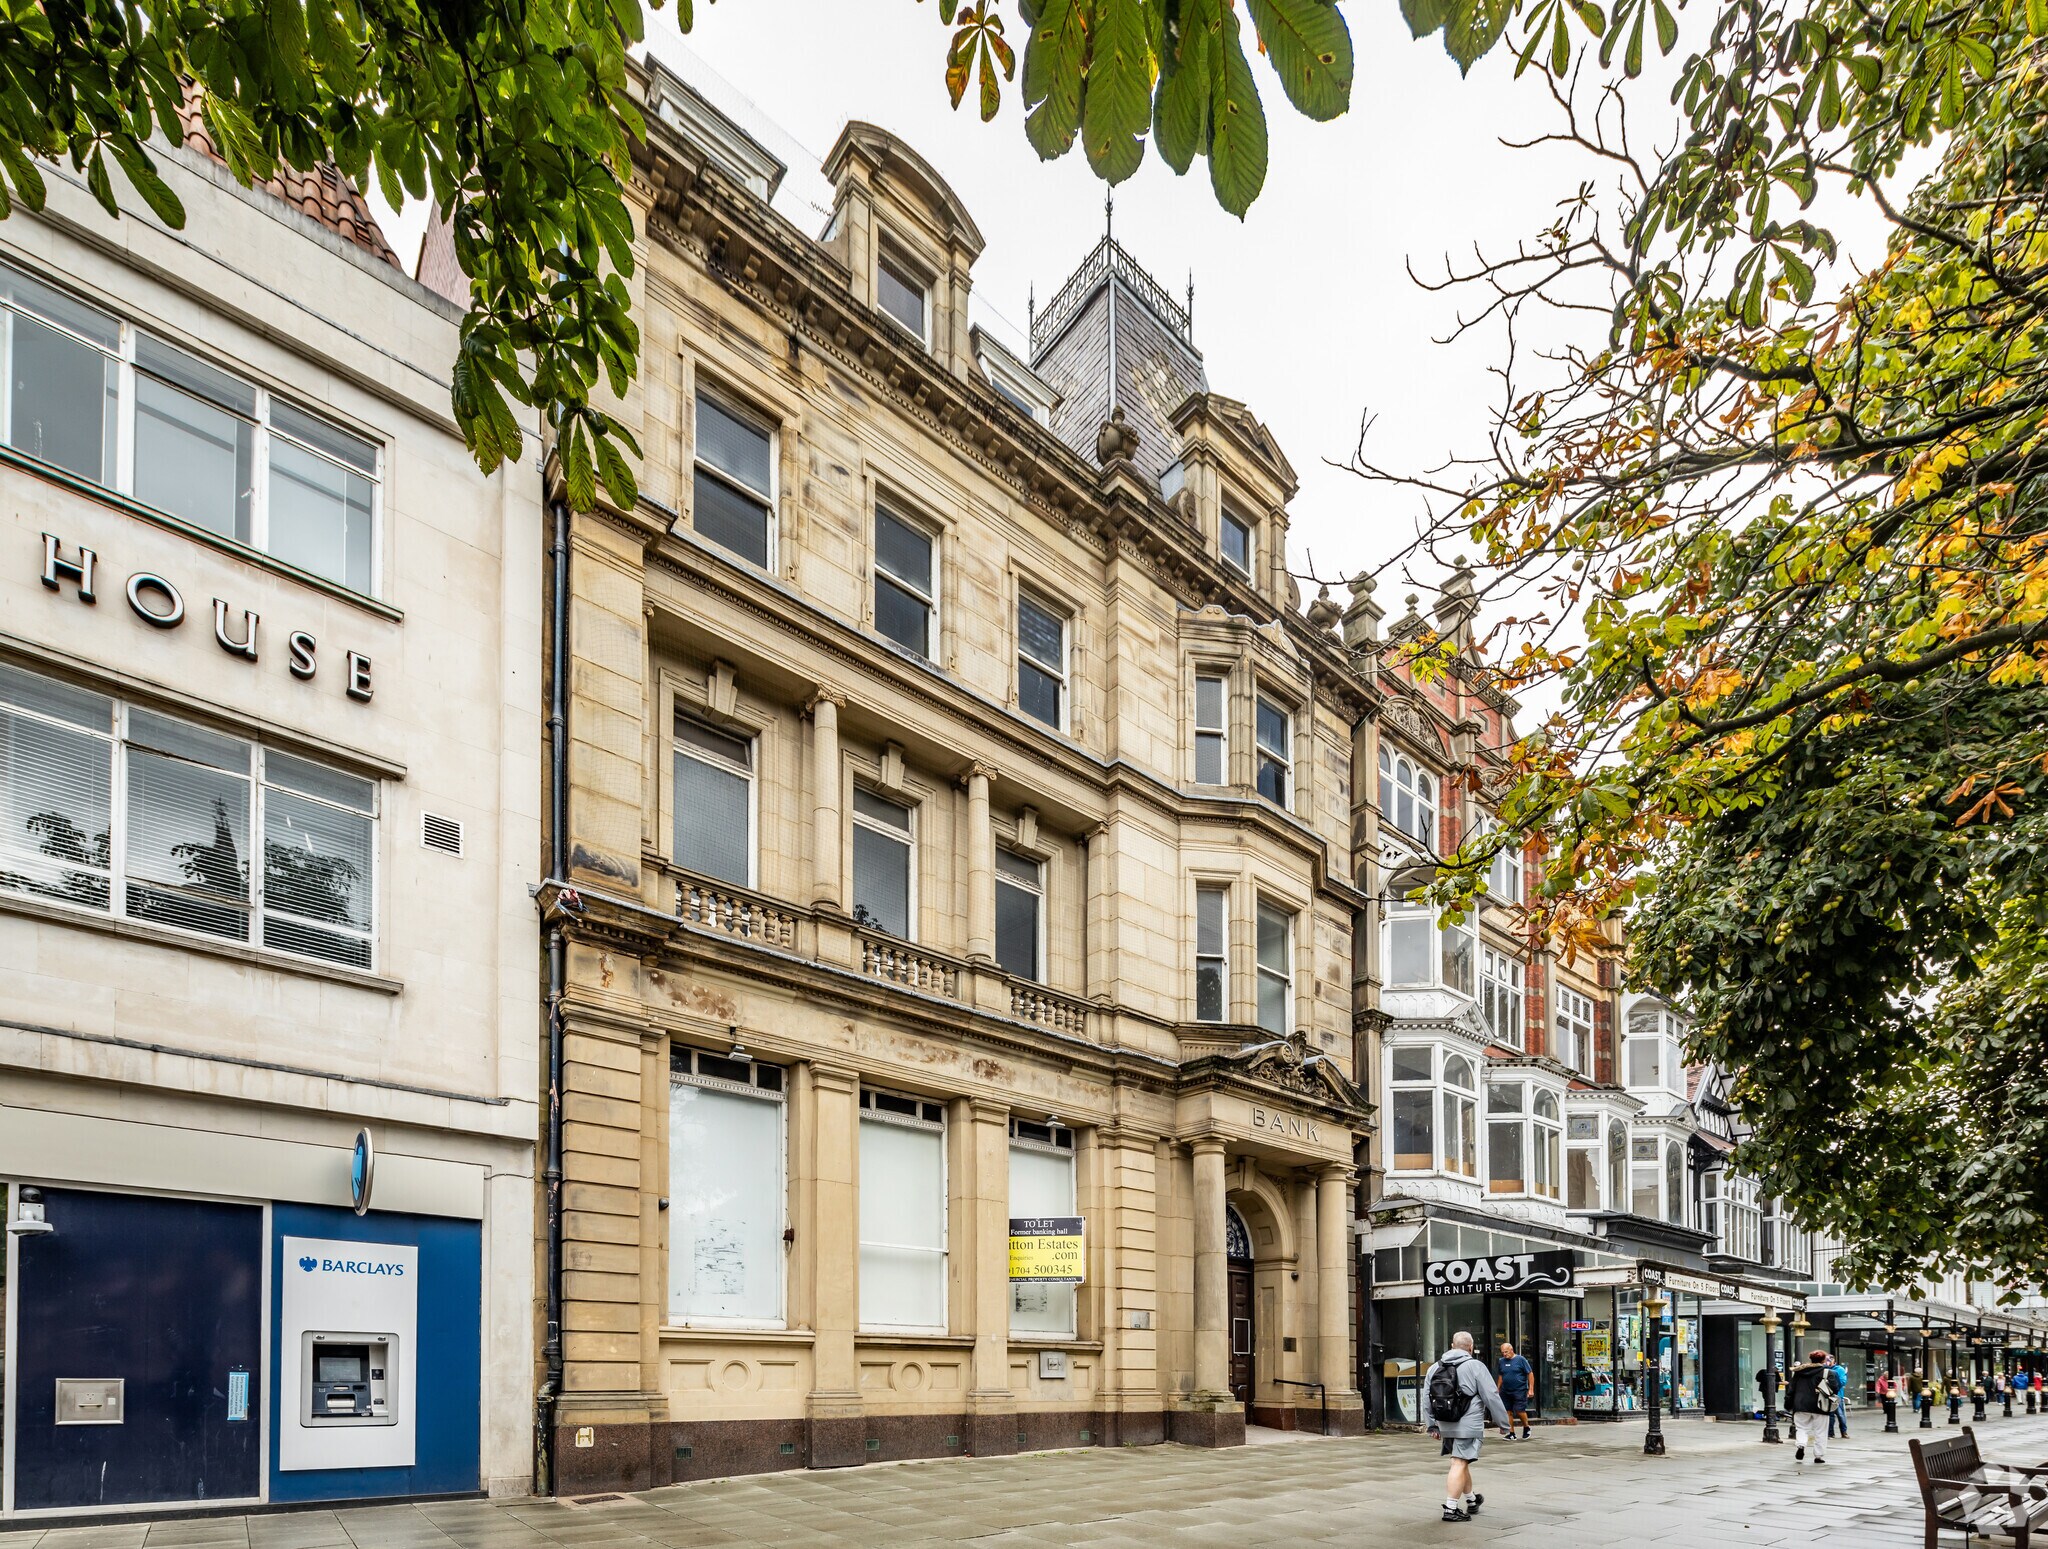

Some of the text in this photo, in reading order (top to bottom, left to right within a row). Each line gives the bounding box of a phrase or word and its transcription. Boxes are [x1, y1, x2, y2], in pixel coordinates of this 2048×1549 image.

[40, 531, 375, 703] HOUSE
[1253, 1107, 1319, 1142] BANK
[1024, 1220, 1055, 1228] TO LET
[1032, 1228, 1056, 1236] banking
[1008, 1238, 1079, 1250] itton Estates
[1052, 1251, 1078, 1260] .com
[322, 1259, 404, 1276] BARCLAYS
[1034, 1264, 1073, 1275] 500345
[1426, 1254, 1535, 1286] COAST
[1644, 1268, 1661, 1282] COAST
[1428, 1283, 1501, 1296] FURNITURE
[1669, 1276, 1691, 1289] Furniture
[1693, 1280, 1700, 1290] On
[1705, 1283, 1719, 1294] Floors
[1721, 1284, 1735, 1296] COAST
[1751, 1292, 1769, 1303] Furniture
